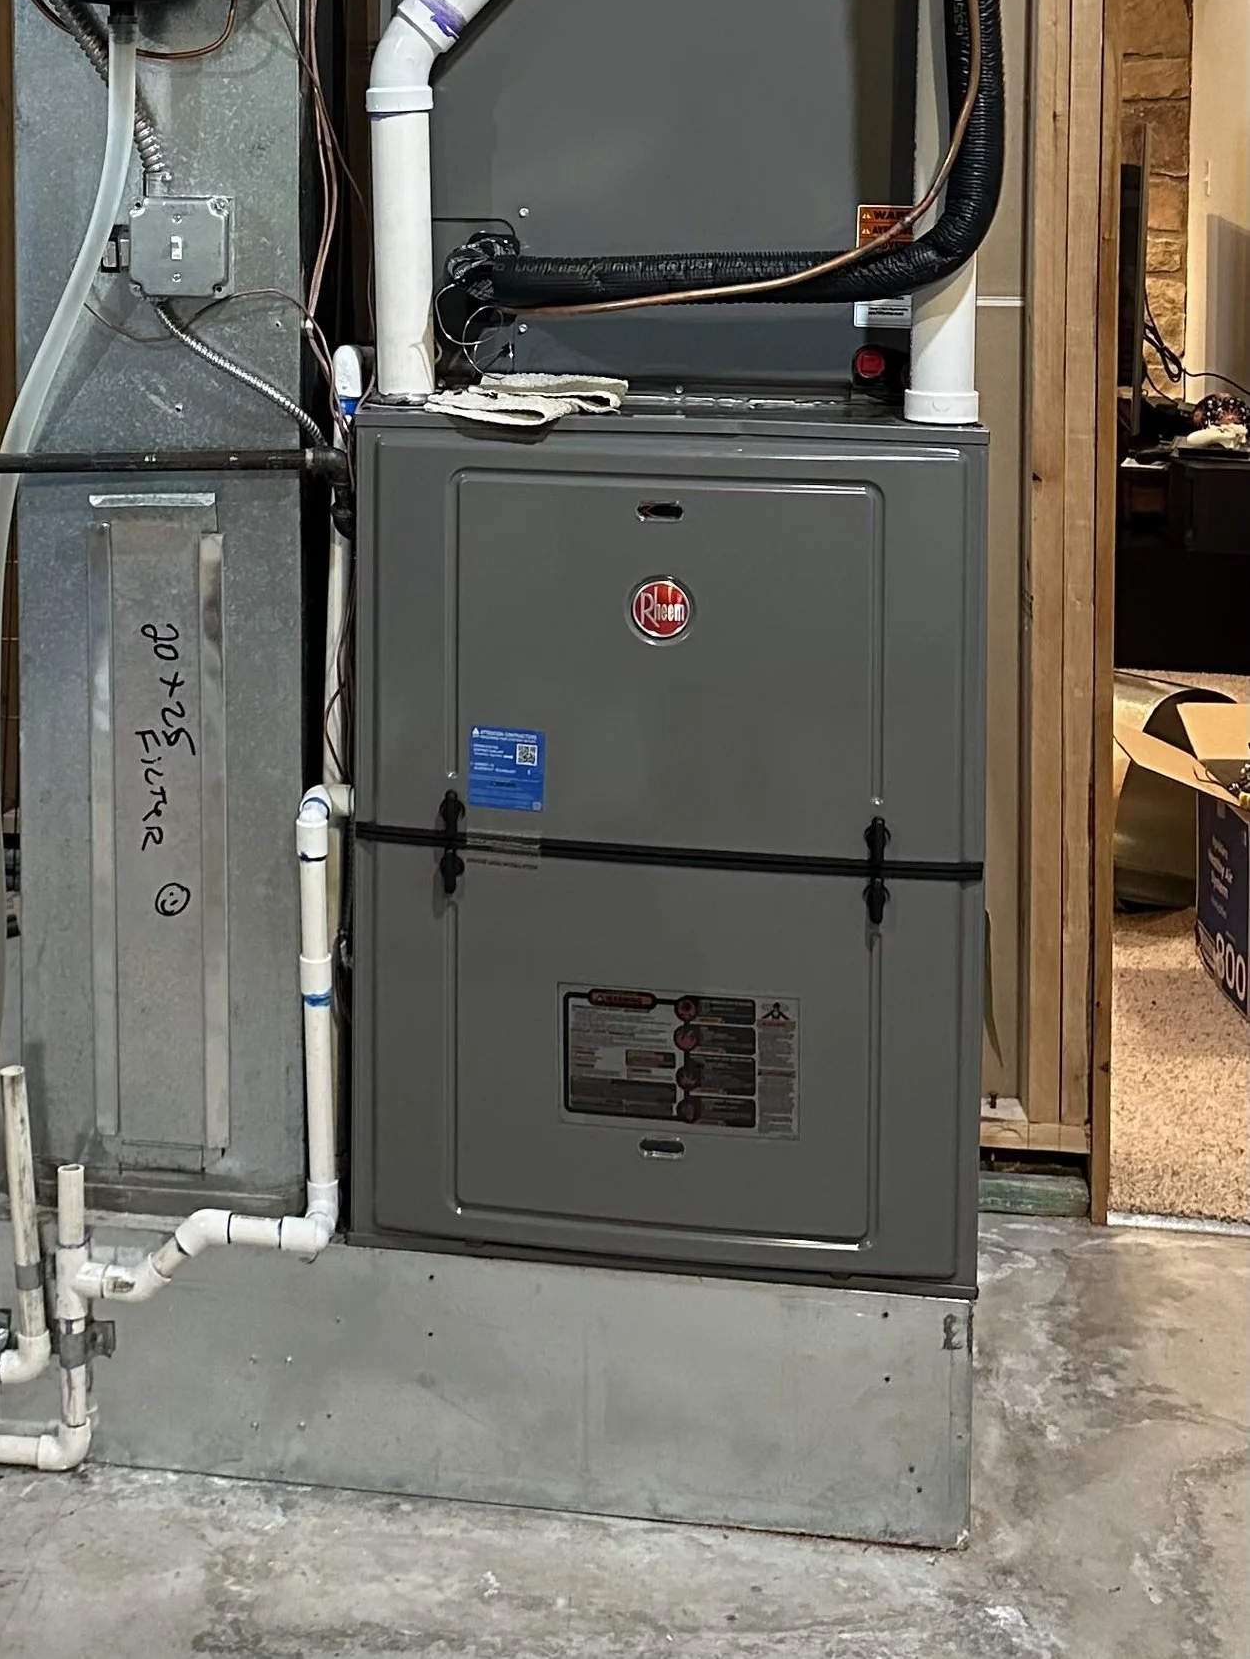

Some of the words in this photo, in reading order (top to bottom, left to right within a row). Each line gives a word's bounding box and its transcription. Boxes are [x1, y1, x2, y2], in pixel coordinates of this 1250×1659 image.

[640, 585, 686, 628] Rheem
[140, 622, 180, 662] 20
[1213, 931, 1248, 1003] 800
